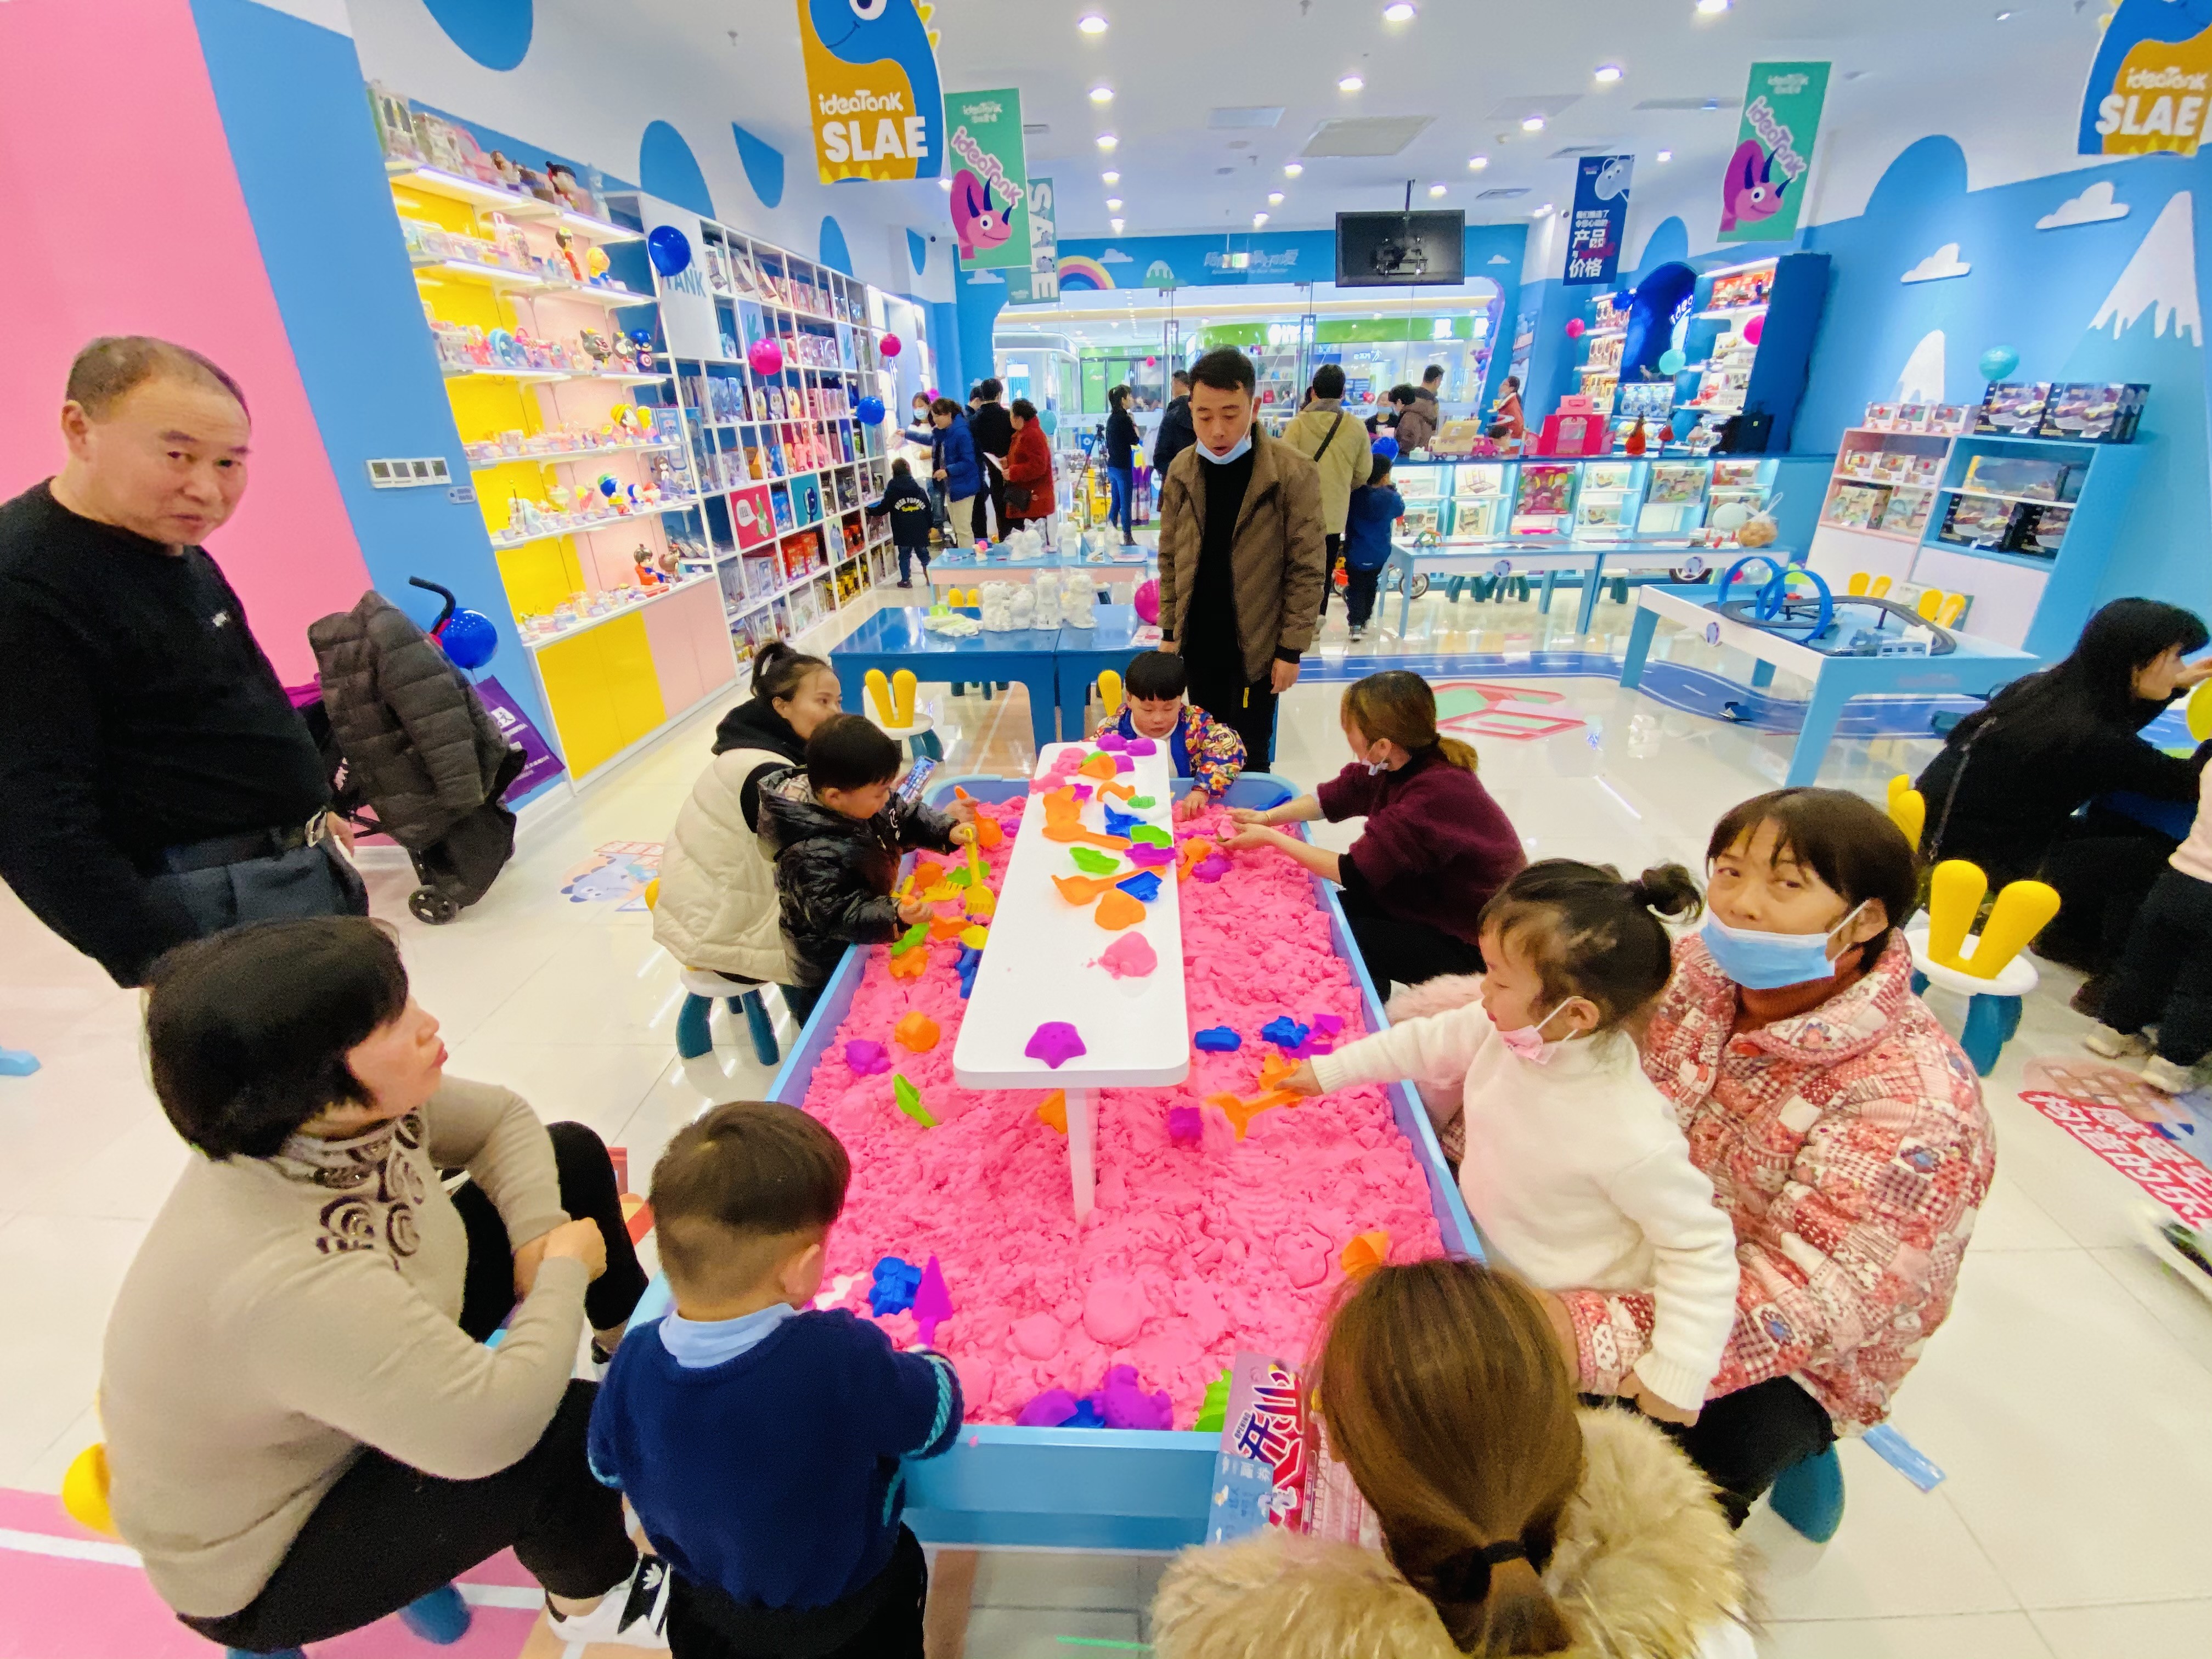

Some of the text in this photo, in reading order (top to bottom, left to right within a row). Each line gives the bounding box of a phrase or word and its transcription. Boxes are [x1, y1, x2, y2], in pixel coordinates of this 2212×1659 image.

[2095, 93, 2204, 137] SLAE
[822, 116, 929, 163] SLAE
[1027, 183, 1058, 300] SALE
[1572, 229, 1606, 249] 产品
[1569, 258, 1603, 278] 价格
